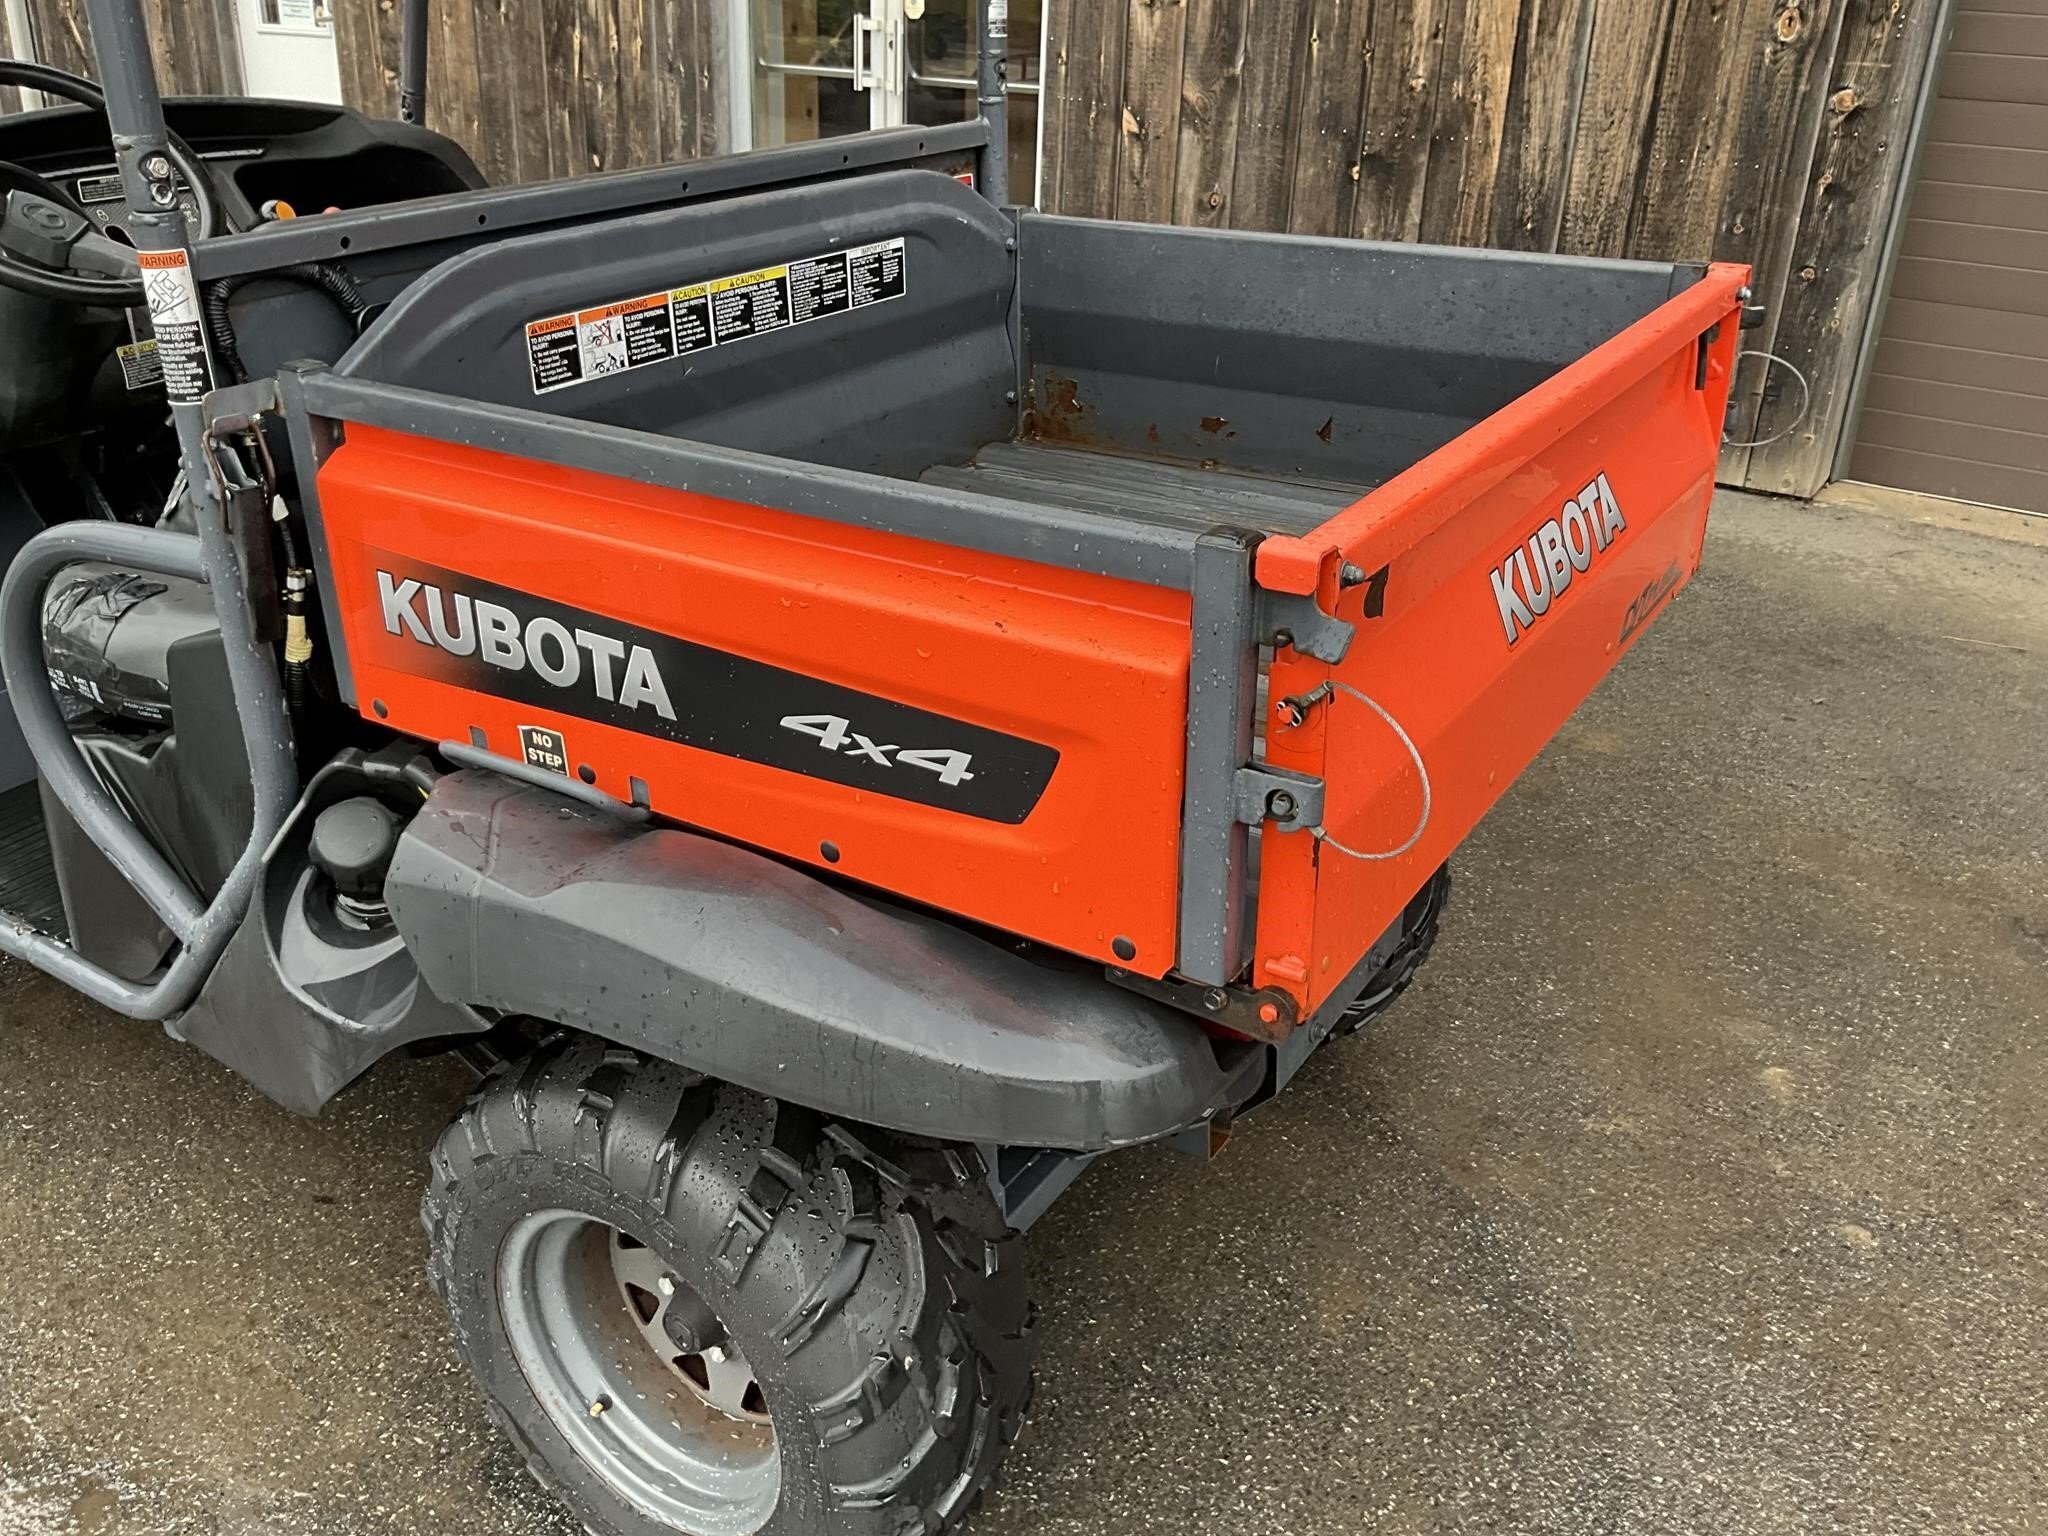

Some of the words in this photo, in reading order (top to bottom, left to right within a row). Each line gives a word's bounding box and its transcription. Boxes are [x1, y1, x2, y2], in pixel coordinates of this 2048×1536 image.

[735, 272, 764, 285] CAUTION
[678, 286, 705, 299] CAUTION
[719, 289, 734, 298] AVOID
[735, 283, 758, 295] PERSONAL
[612, 300, 647, 314] WARNING
[630, 312, 643, 321] AVOID
[643, 307, 664, 318] PERSONAL
[165, 324, 198, 332] PERSONAL
[538, 317, 572, 332] WARNING
[537, 334, 551, 342] AVOID
[551, 329, 574, 339] PERSONAL
[1489, 470, 1626, 646] KUBOTA
[376, 569, 678, 721] KUBOTA
[780, 715, 974, 786] 4x4
[532, 731, 552, 748] NO
[528, 747, 562, 767] STEP
